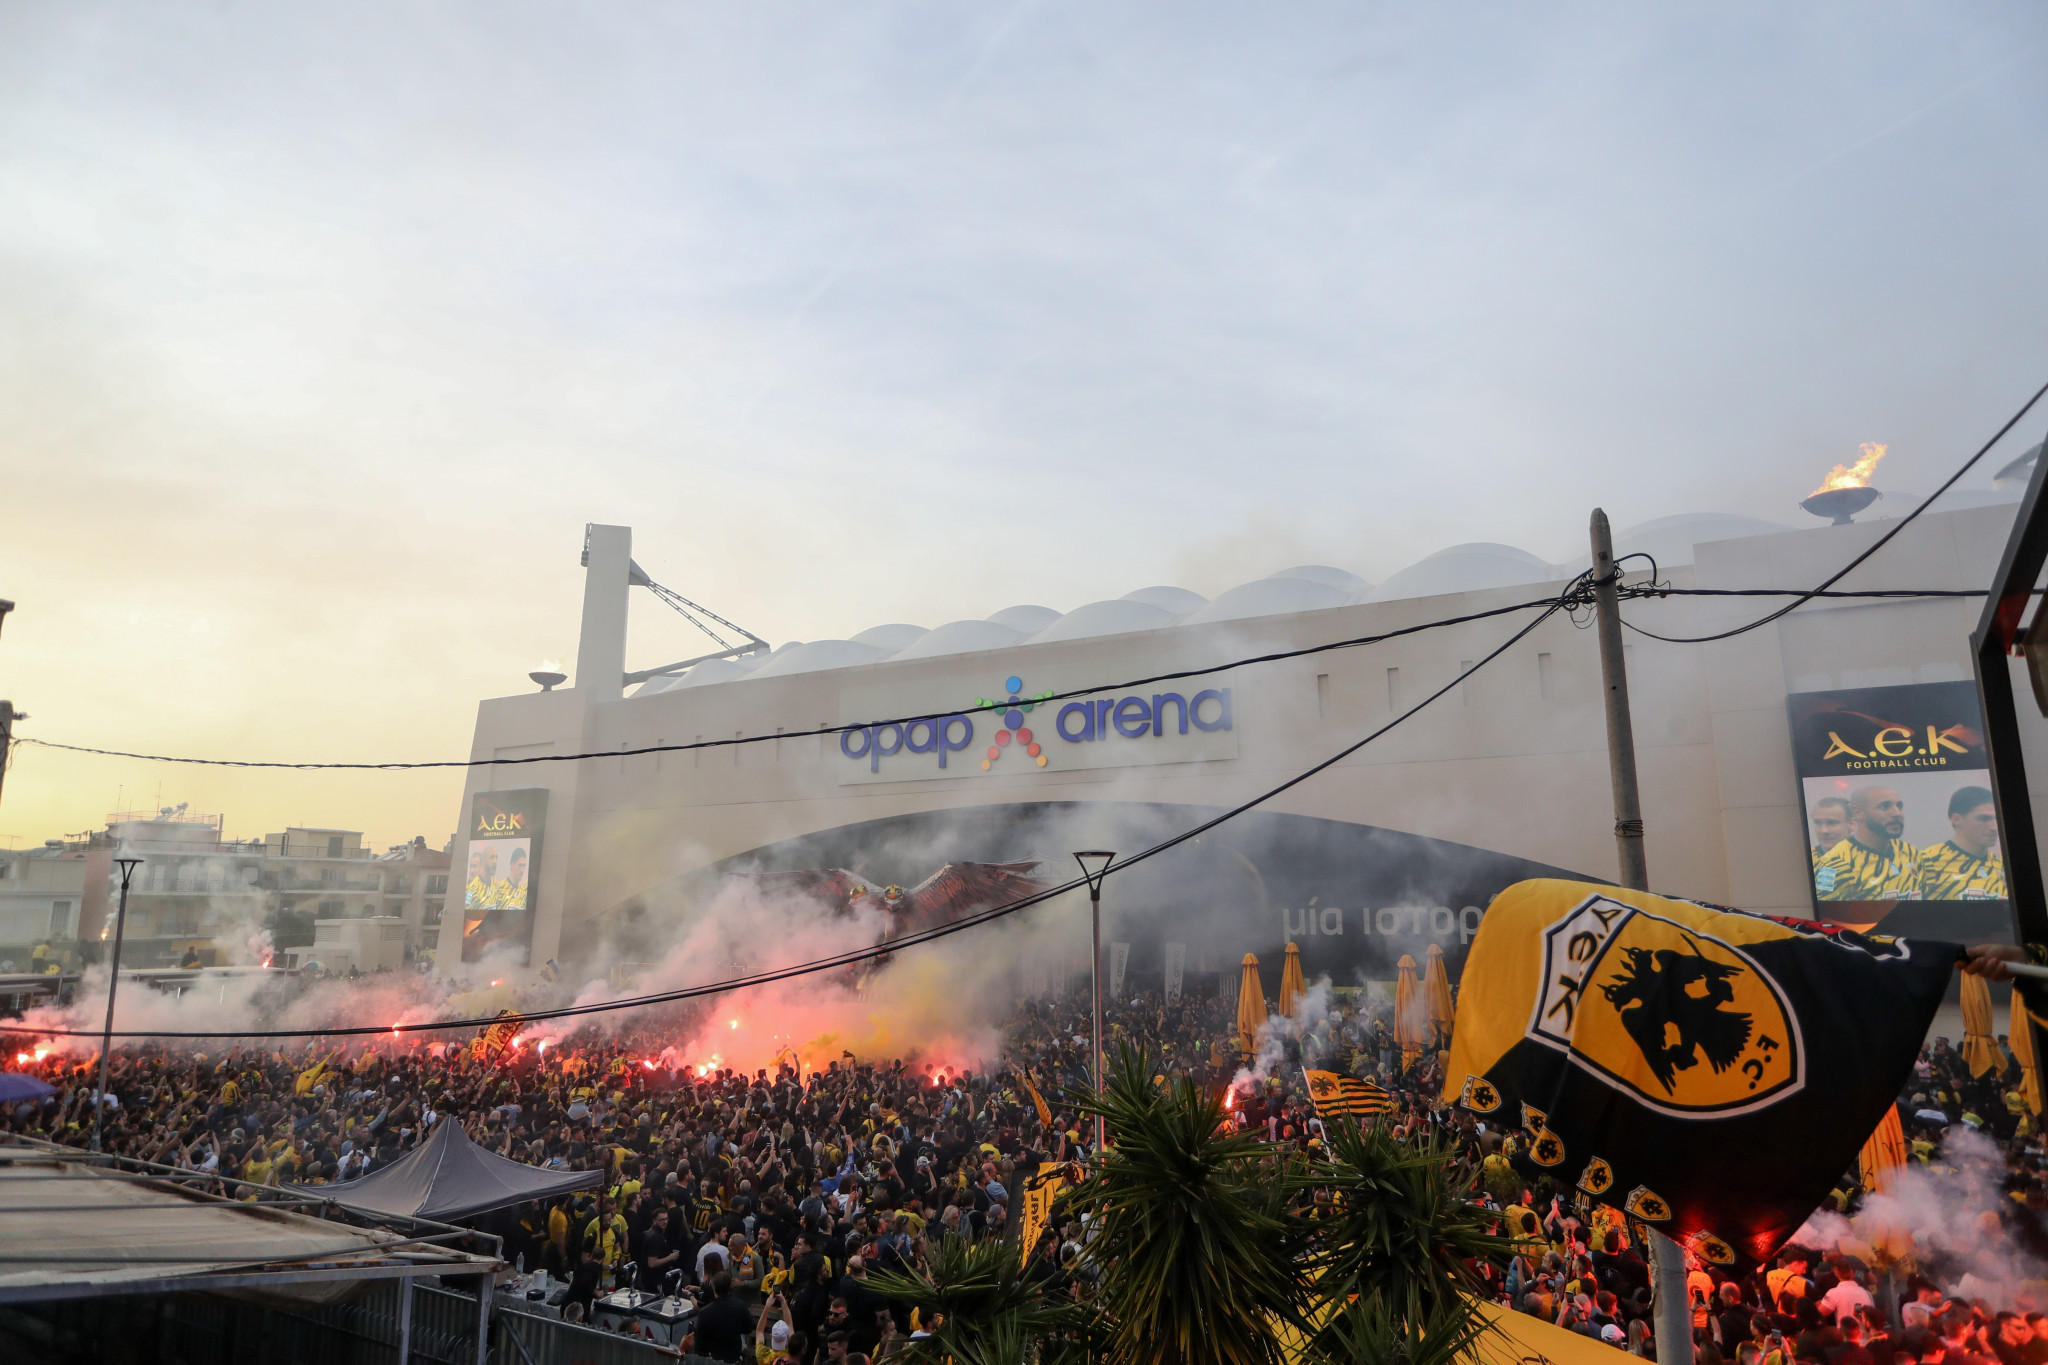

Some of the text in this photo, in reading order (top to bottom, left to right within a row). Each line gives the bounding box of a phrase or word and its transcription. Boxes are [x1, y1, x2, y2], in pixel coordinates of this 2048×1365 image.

[840, 688, 1233, 773] opap arena
[1846, 757, 1947, 769] FOOTBALL CLUB
[1282, 894, 1498, 945] μία ιστορ
[1116, 949, 1125, 977] arena
[693, 1209, 711, 1229] 10
